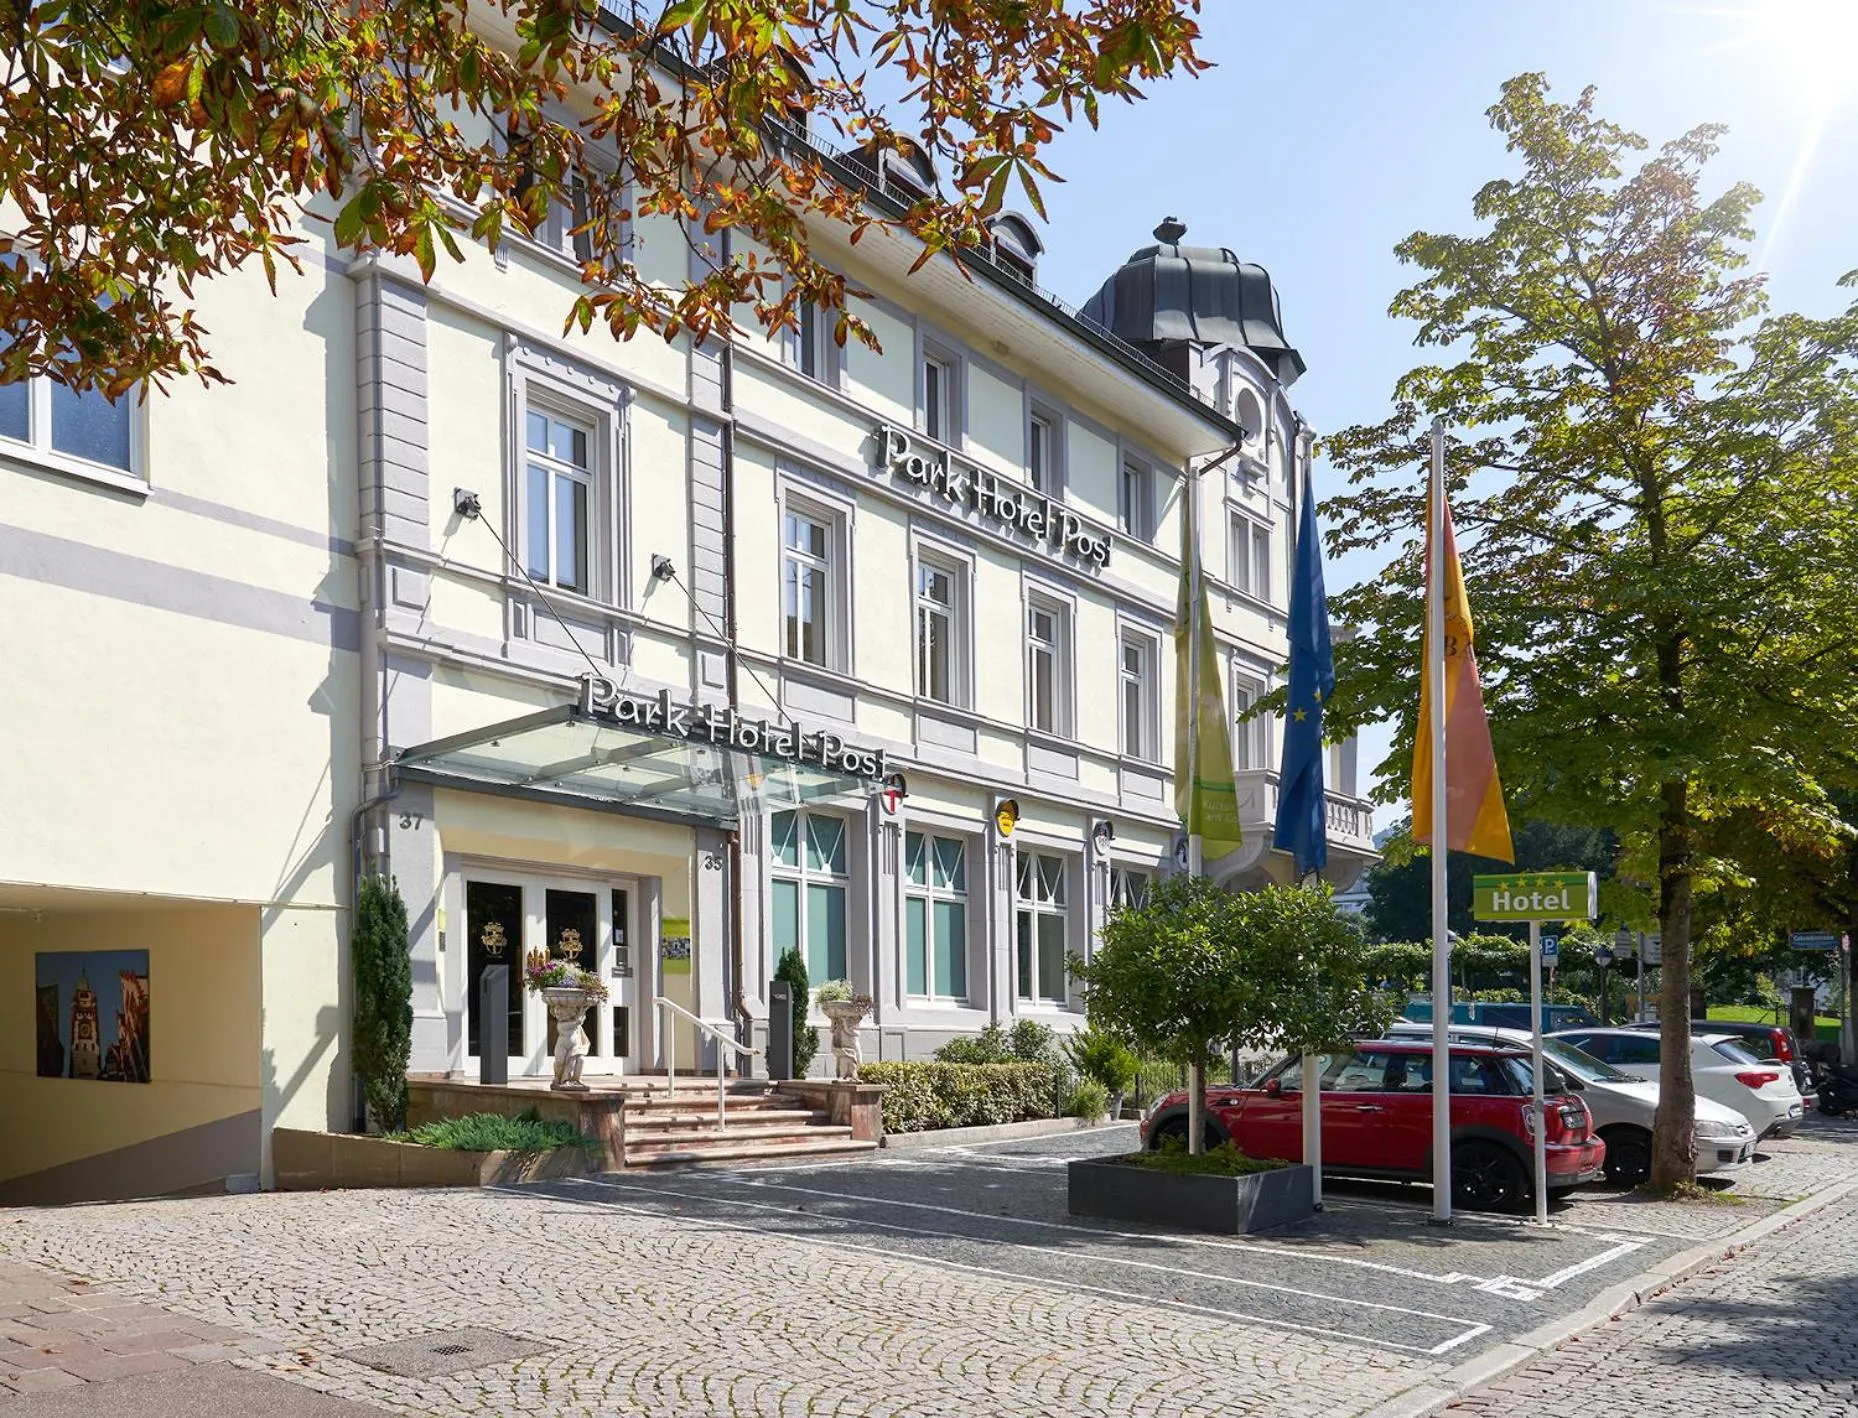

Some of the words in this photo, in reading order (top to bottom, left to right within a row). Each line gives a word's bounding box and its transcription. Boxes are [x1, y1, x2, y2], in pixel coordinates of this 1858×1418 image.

[879, 423, 970, 502] Park
[972, 469, 1051, 539] Hotel
[1059, 508, 1114, 568] Post
[580, 673, 690, 737] Park
[704, 702, 804, 761] Hotel
[817, 729, 888, 780] Post
[399, 811, 424, 831] 37
[704, 855, 723, 871] 35
[1491, 888, 1571, 912] Hotel
[1544, 938, 1555, 954] P
